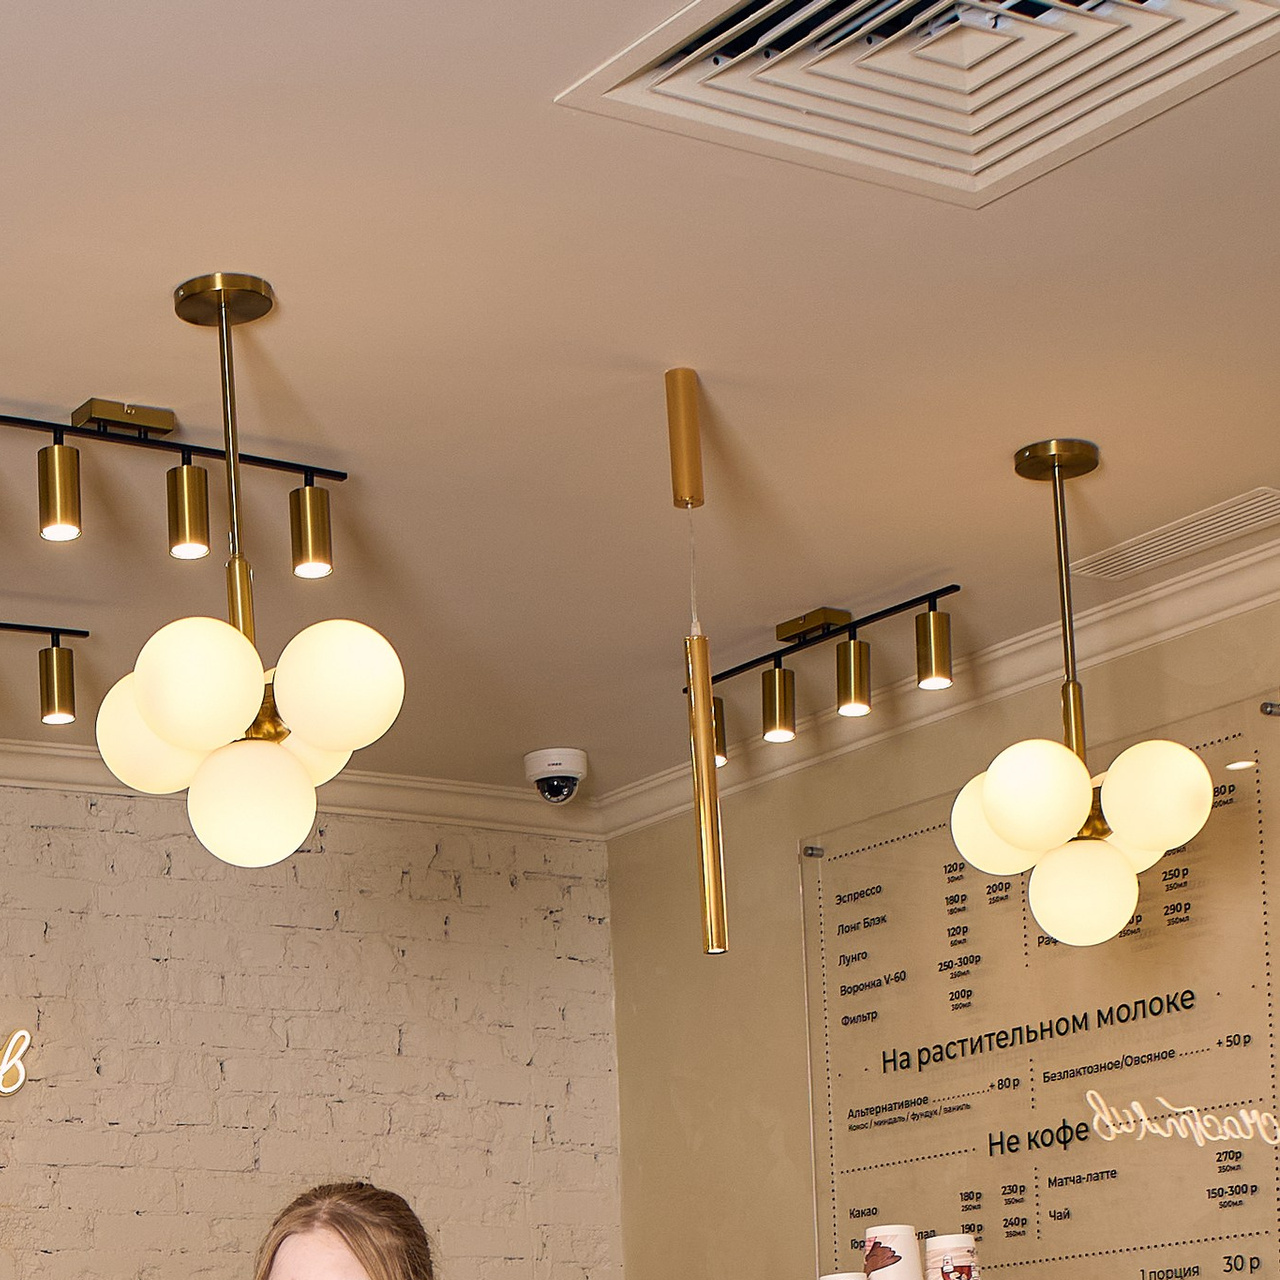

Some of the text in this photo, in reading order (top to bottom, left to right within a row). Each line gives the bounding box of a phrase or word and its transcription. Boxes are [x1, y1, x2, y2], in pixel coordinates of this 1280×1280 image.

[835, 884, 883, 905] Эспрессо
[836, 913, 888, 936] Лонг Блэк
[838, 950, 868, 967] Лунго
[839, 970, 907, 997] Воронка V-60
[840, 1009, 878, 1027] Фильтр
[881, 989, 1196, 1074] На растительном молоке
[847, 1095, 929, 1120] Альтернативное
[987, 1117, 1090, 1157] Не кофе
[1047, 1167, 1118, 1188] Матча-латте
[849, 1206, 879, 1219] Какао
[1048, 1207, 1071, 1221] Чай
[1222, 1255, 1245, 1273] 30
